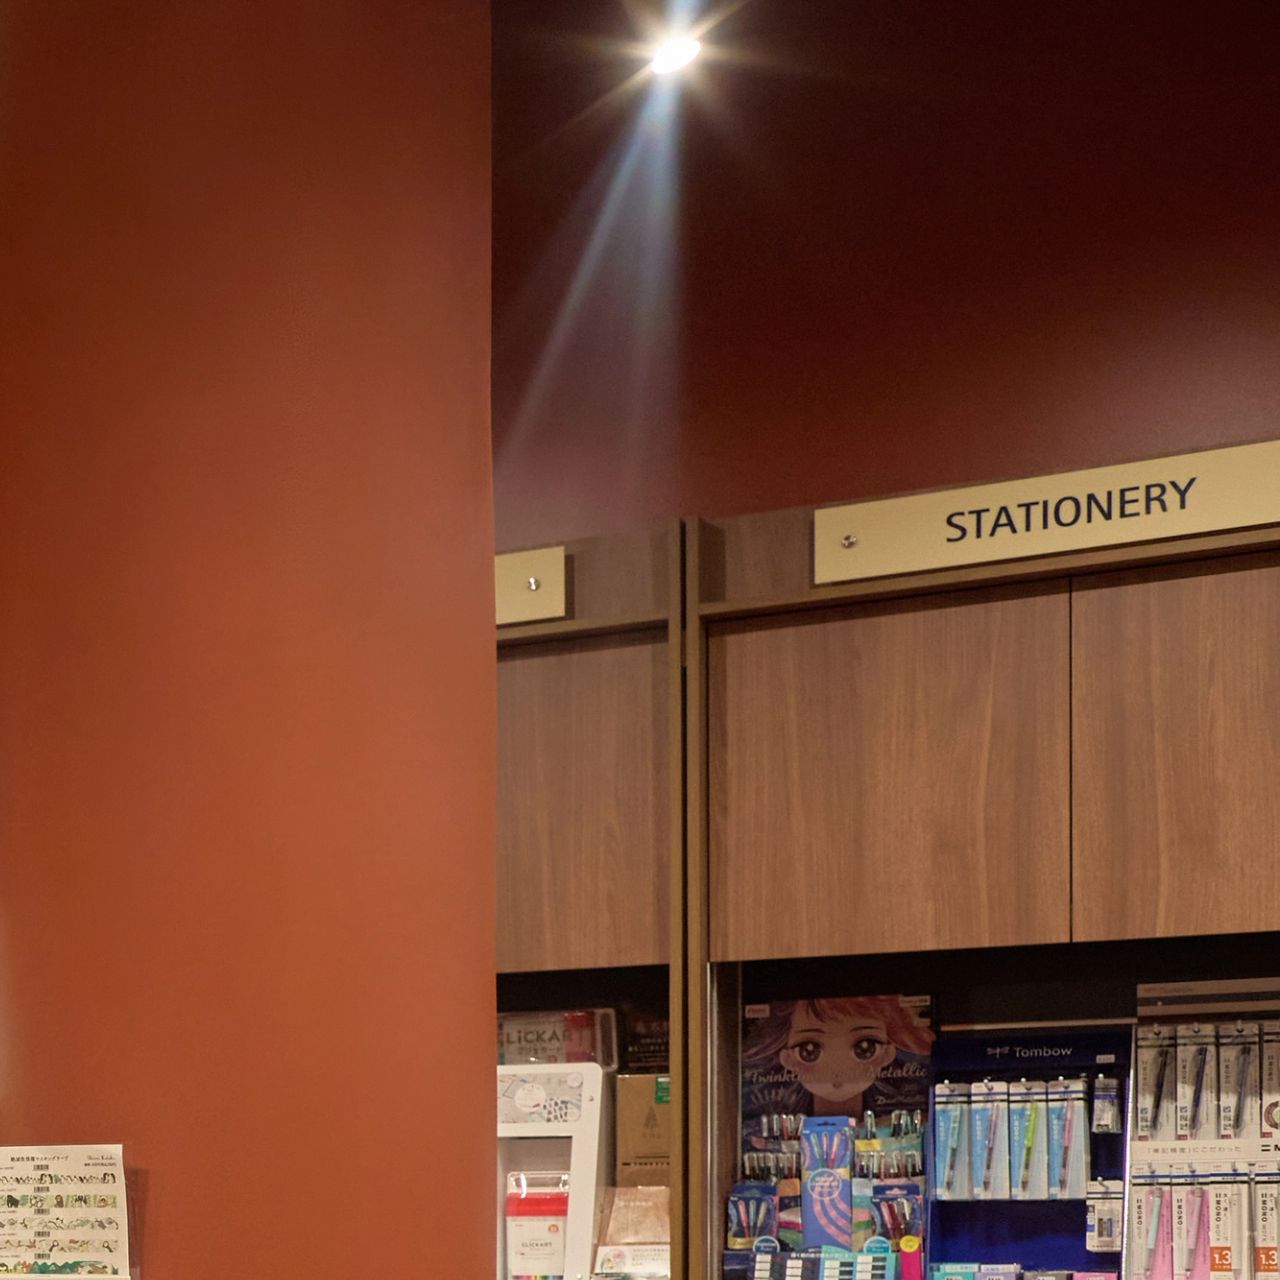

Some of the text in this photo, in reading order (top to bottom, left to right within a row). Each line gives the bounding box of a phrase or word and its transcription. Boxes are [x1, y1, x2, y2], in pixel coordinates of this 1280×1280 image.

[946, 476, 1198, 543] STATIONERY
[1013, 1043, 1073, 1059] Tombow
[1214, 1251, 1231, 1264] 1.3
[1260, 1251, 1278, 1264] 1.3
